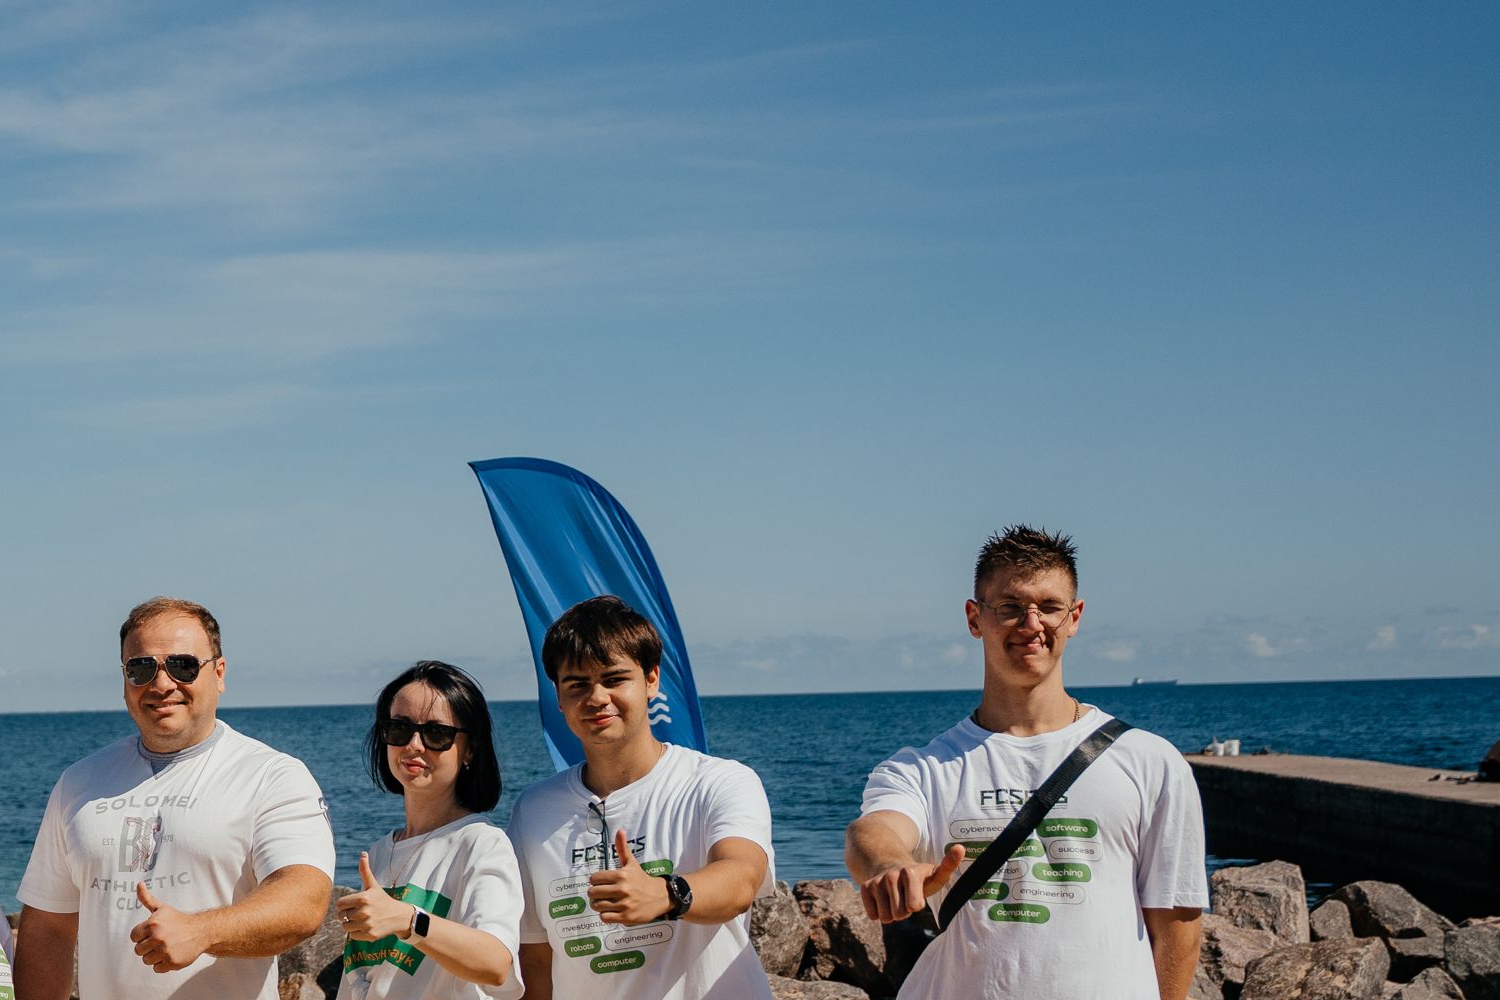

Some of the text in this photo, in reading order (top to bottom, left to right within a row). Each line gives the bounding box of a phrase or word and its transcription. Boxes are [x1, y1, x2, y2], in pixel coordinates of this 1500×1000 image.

[960, 824, 1088, 834] cybersec software
[1058, 847, 1095, 855] success
[1042, 869, 1084, 878] teaching
[90, 872, 191, 892] ATHLETIC
[556, 880, 590, 892] cybersec
[1020, 887, 1075, 899] engineering
[116, 897, 143, 911] CLU
[552, 903, 579, 913] science
[996, 908, 1041, 918] computer
[570, 930, 663, 953] robots engineering
[597, 957, 637, 968] computer
